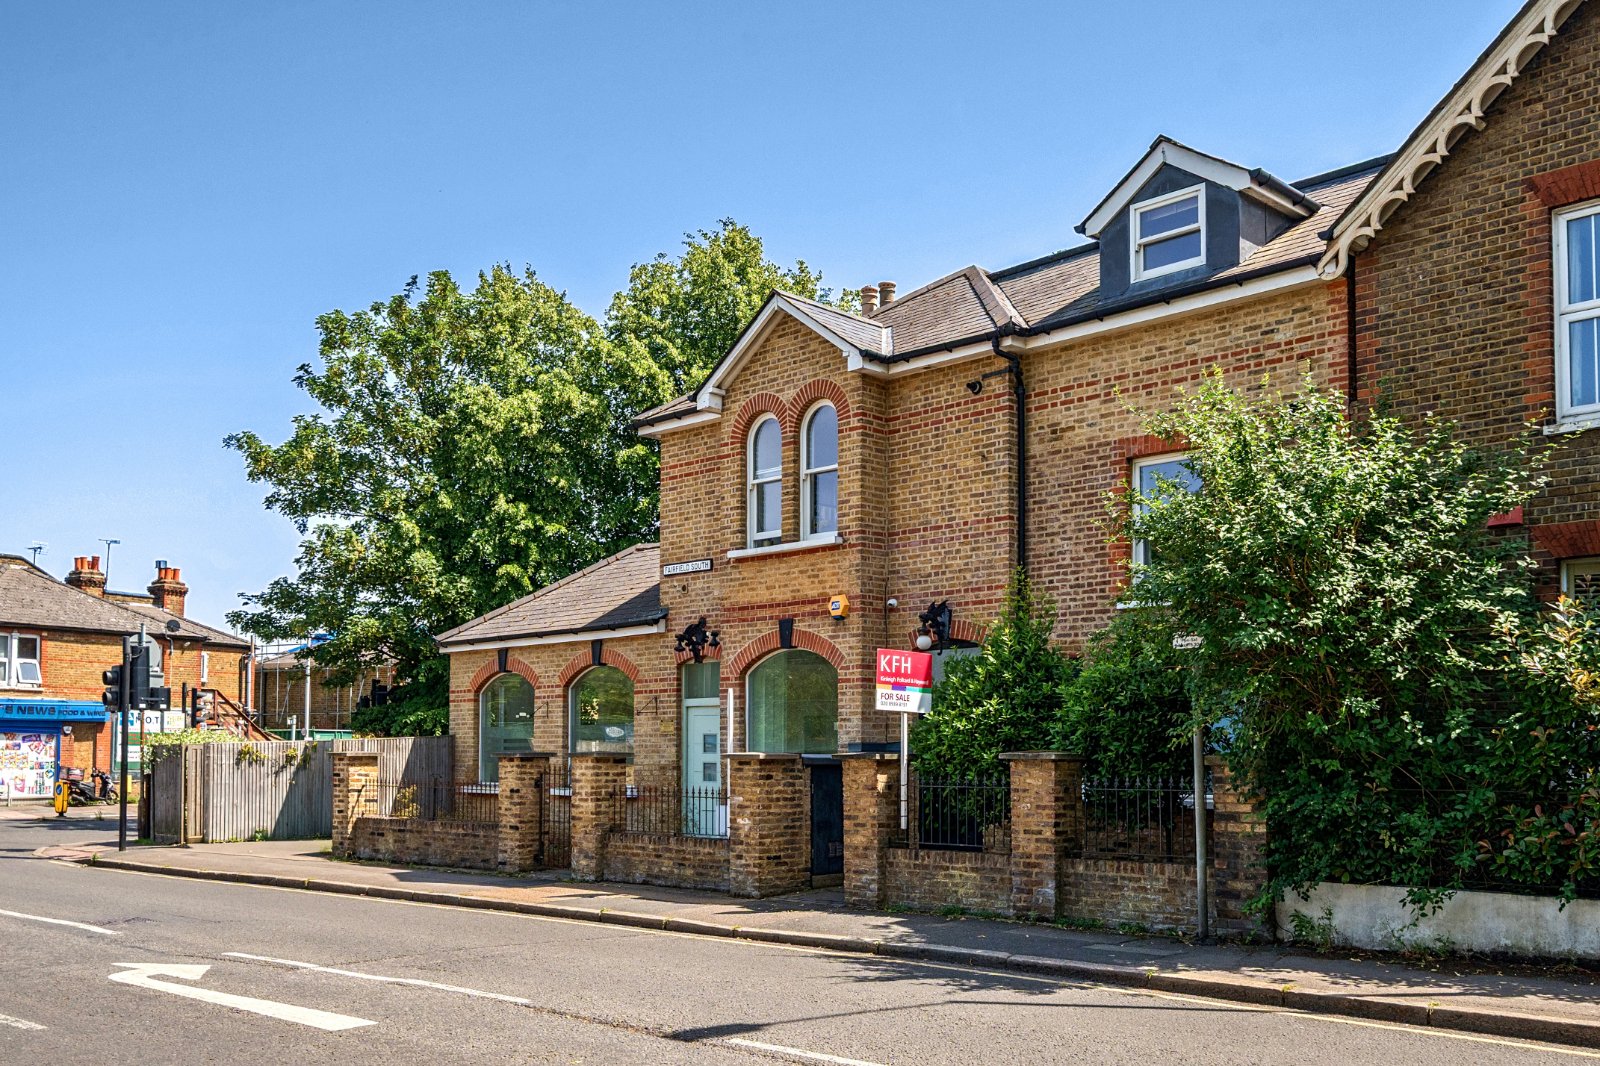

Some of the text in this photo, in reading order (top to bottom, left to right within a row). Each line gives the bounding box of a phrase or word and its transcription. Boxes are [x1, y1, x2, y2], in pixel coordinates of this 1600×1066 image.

[665, 562, 709, 573] FAIRFIELD SOUTH
[880, 654, 911, 674] KFH
[880, 693, 894, 701] FOR
[17, 705, 56, 716] NEWS
